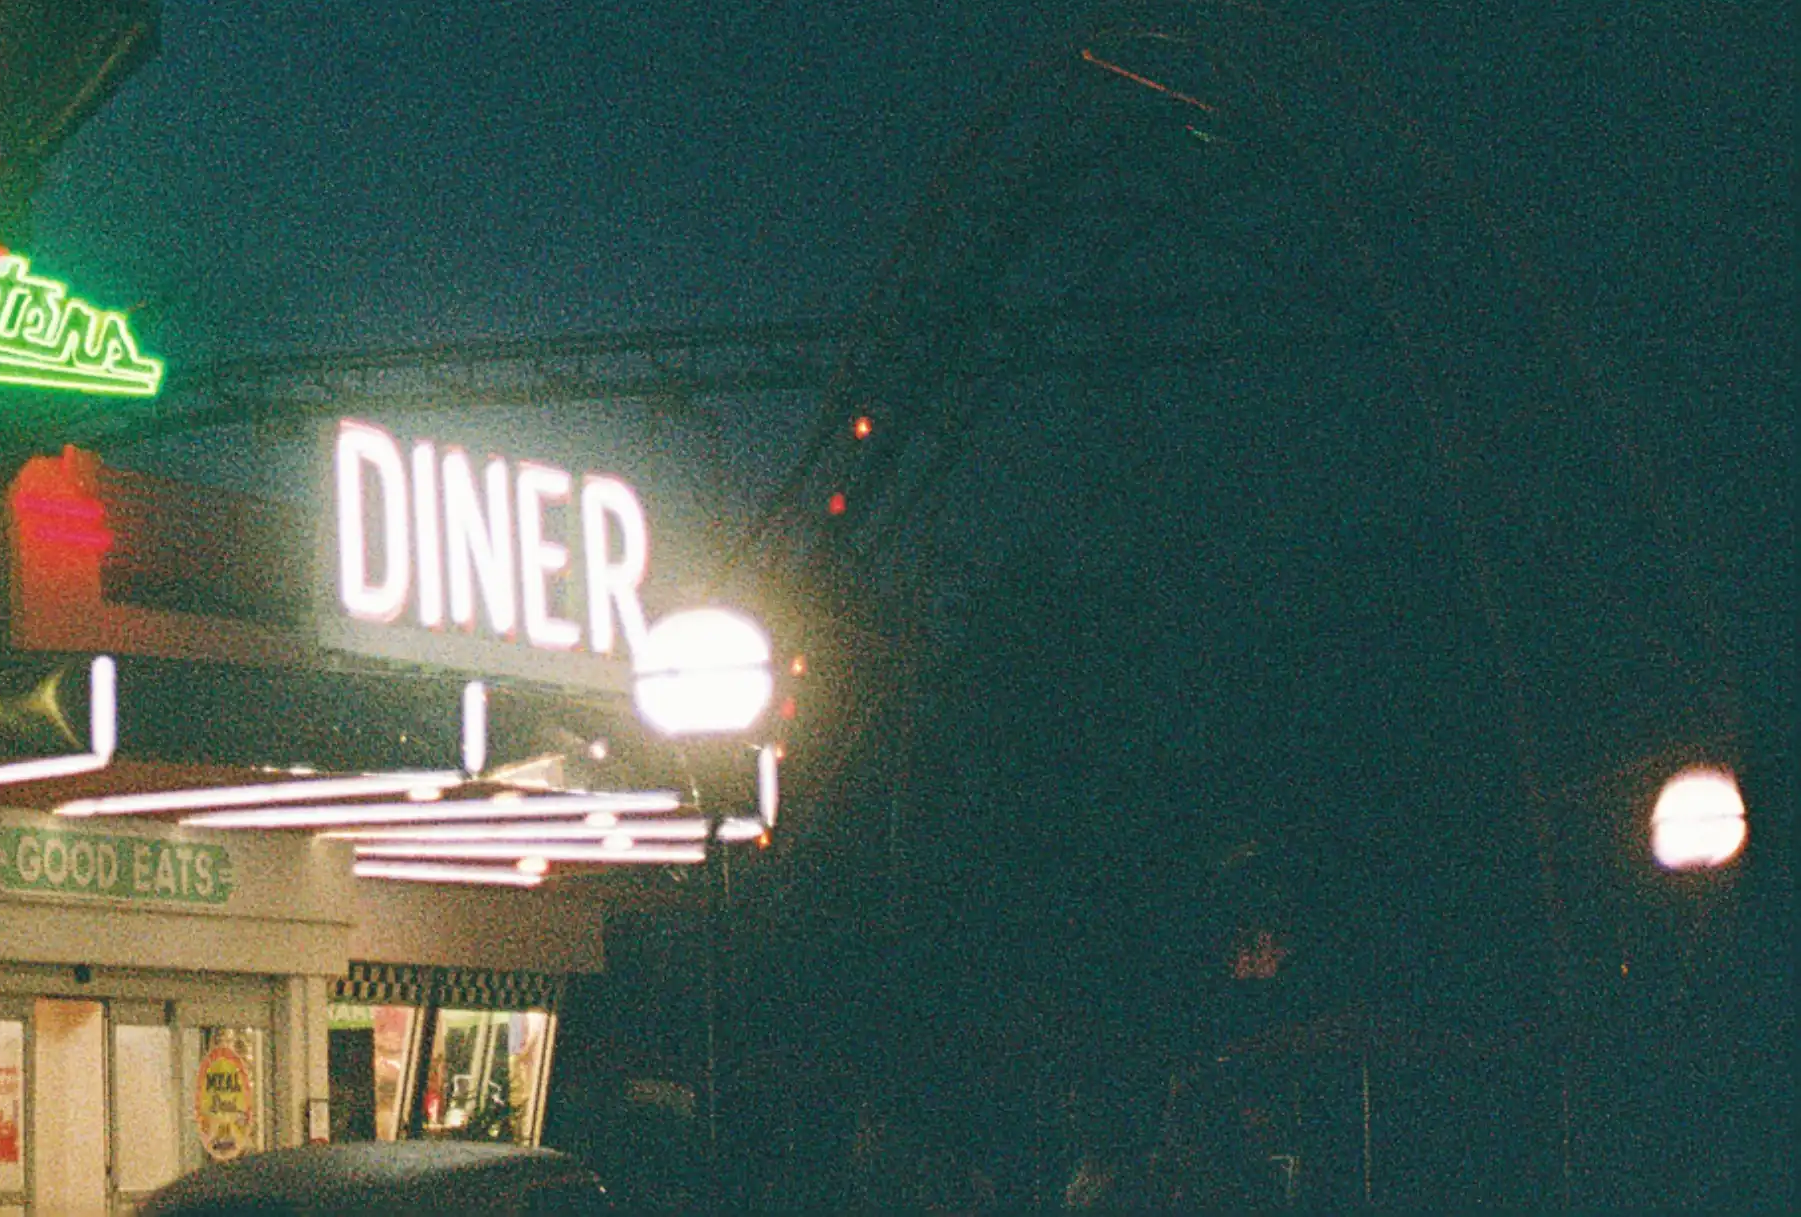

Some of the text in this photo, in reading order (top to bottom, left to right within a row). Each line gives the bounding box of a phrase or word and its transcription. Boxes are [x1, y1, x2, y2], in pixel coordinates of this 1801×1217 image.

[335, 419, 650, 668] DINER
[16, 835, 214, 898] GOOD EATS
